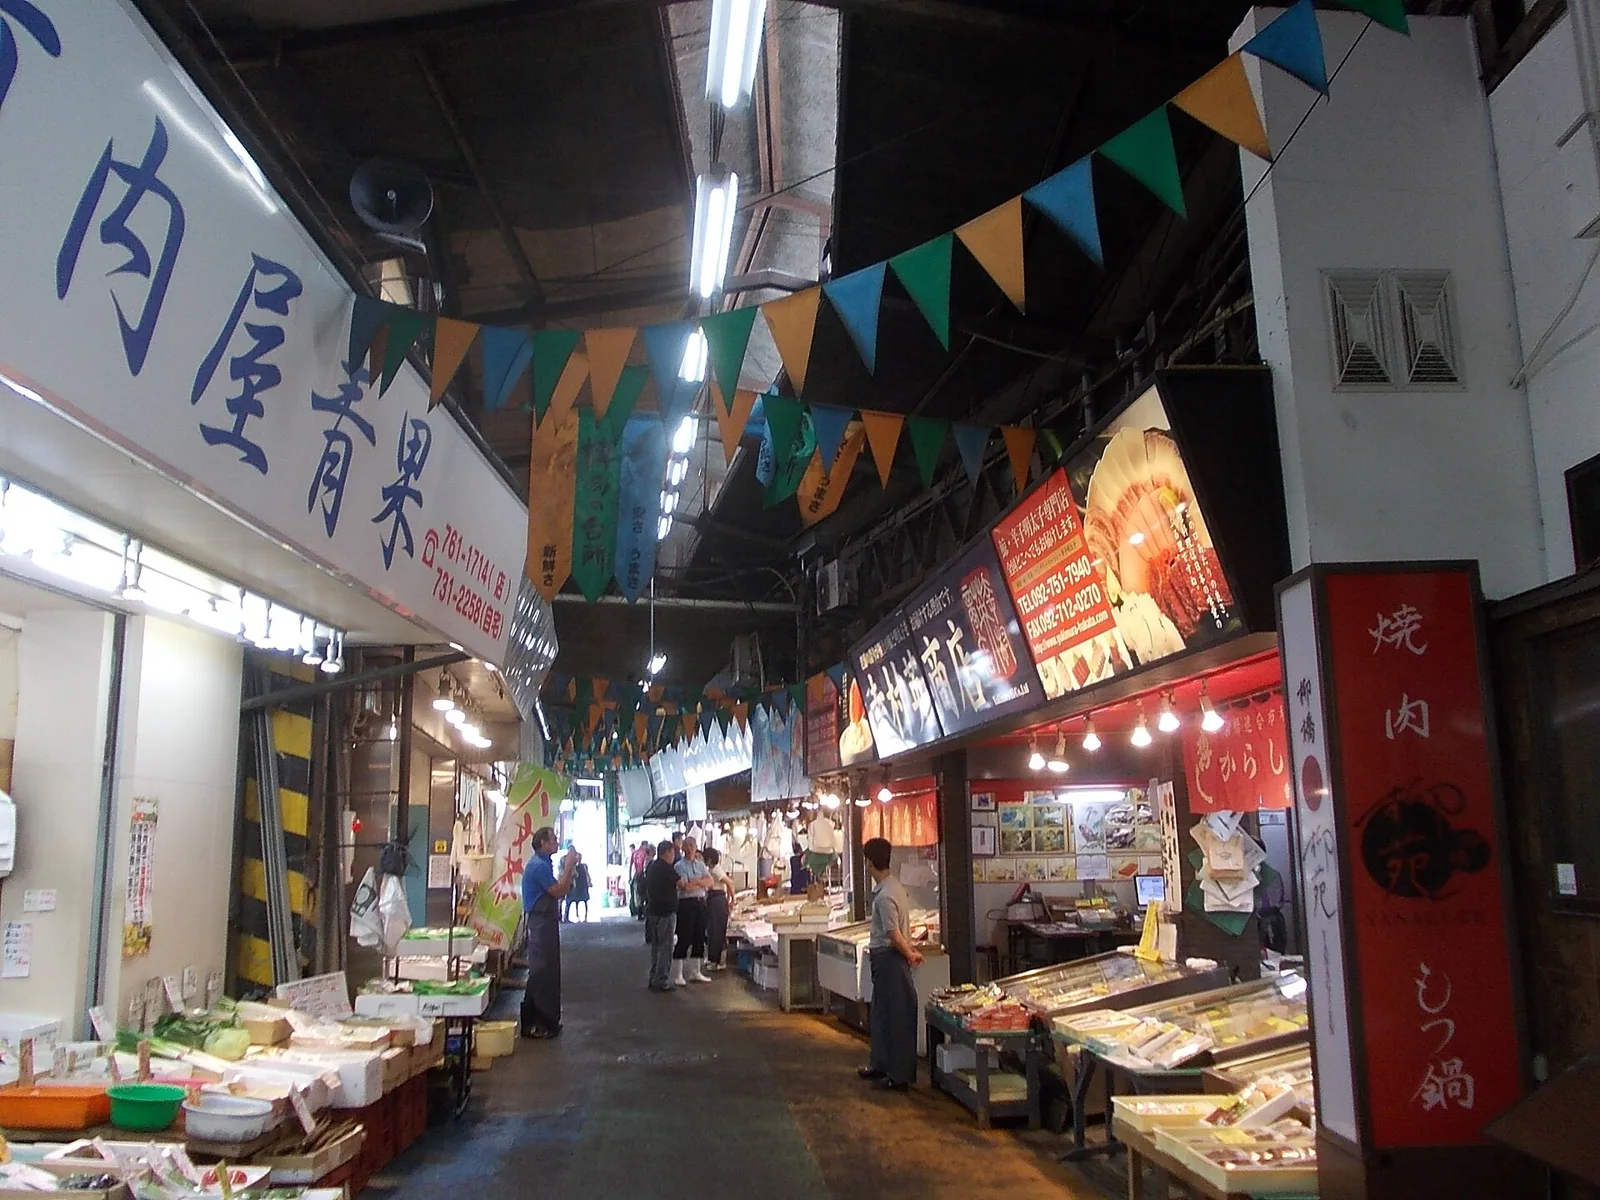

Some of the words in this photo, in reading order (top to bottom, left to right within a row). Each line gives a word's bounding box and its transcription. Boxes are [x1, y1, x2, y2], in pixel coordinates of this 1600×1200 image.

[541, 544, 558, 587] 新鮮さ
[431, 568, 505, 641] 731-2258(自宅)
[1367, 603, 1430, 740] 焼肉
[1297, 677, 1316, 744] 柳橋
[1411, 961, 1475, 1111] もつ鍋
